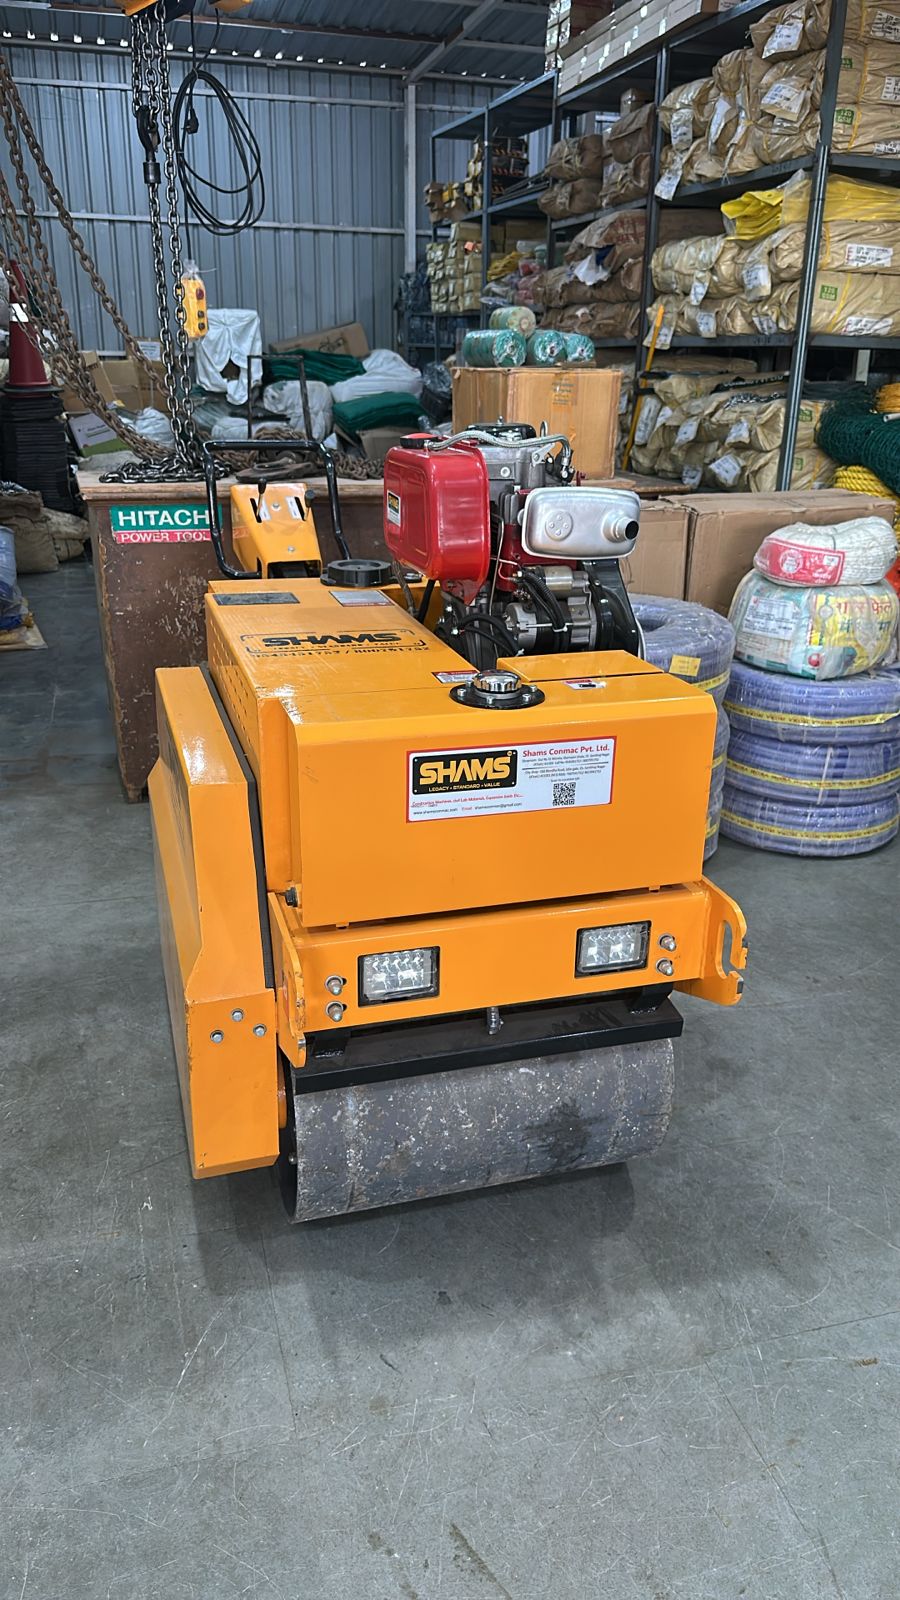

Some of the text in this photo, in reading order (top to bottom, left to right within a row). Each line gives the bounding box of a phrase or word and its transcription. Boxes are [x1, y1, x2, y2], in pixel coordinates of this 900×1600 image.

[117, 509, 211, 527] HITACH
[121, 532, 170, 543] POWER
[262, 632, 402, 647] SHAMS
[522, 750, 548, 758] Shams
[548, 747, 579, 756] Conmac
[596, 744, 610, 752] Ltd.
[419, 755, 511, 785] SHAMS
[428, 785, 450, 793] LEGACY
[452, 783, 480, 791] STANDARD
